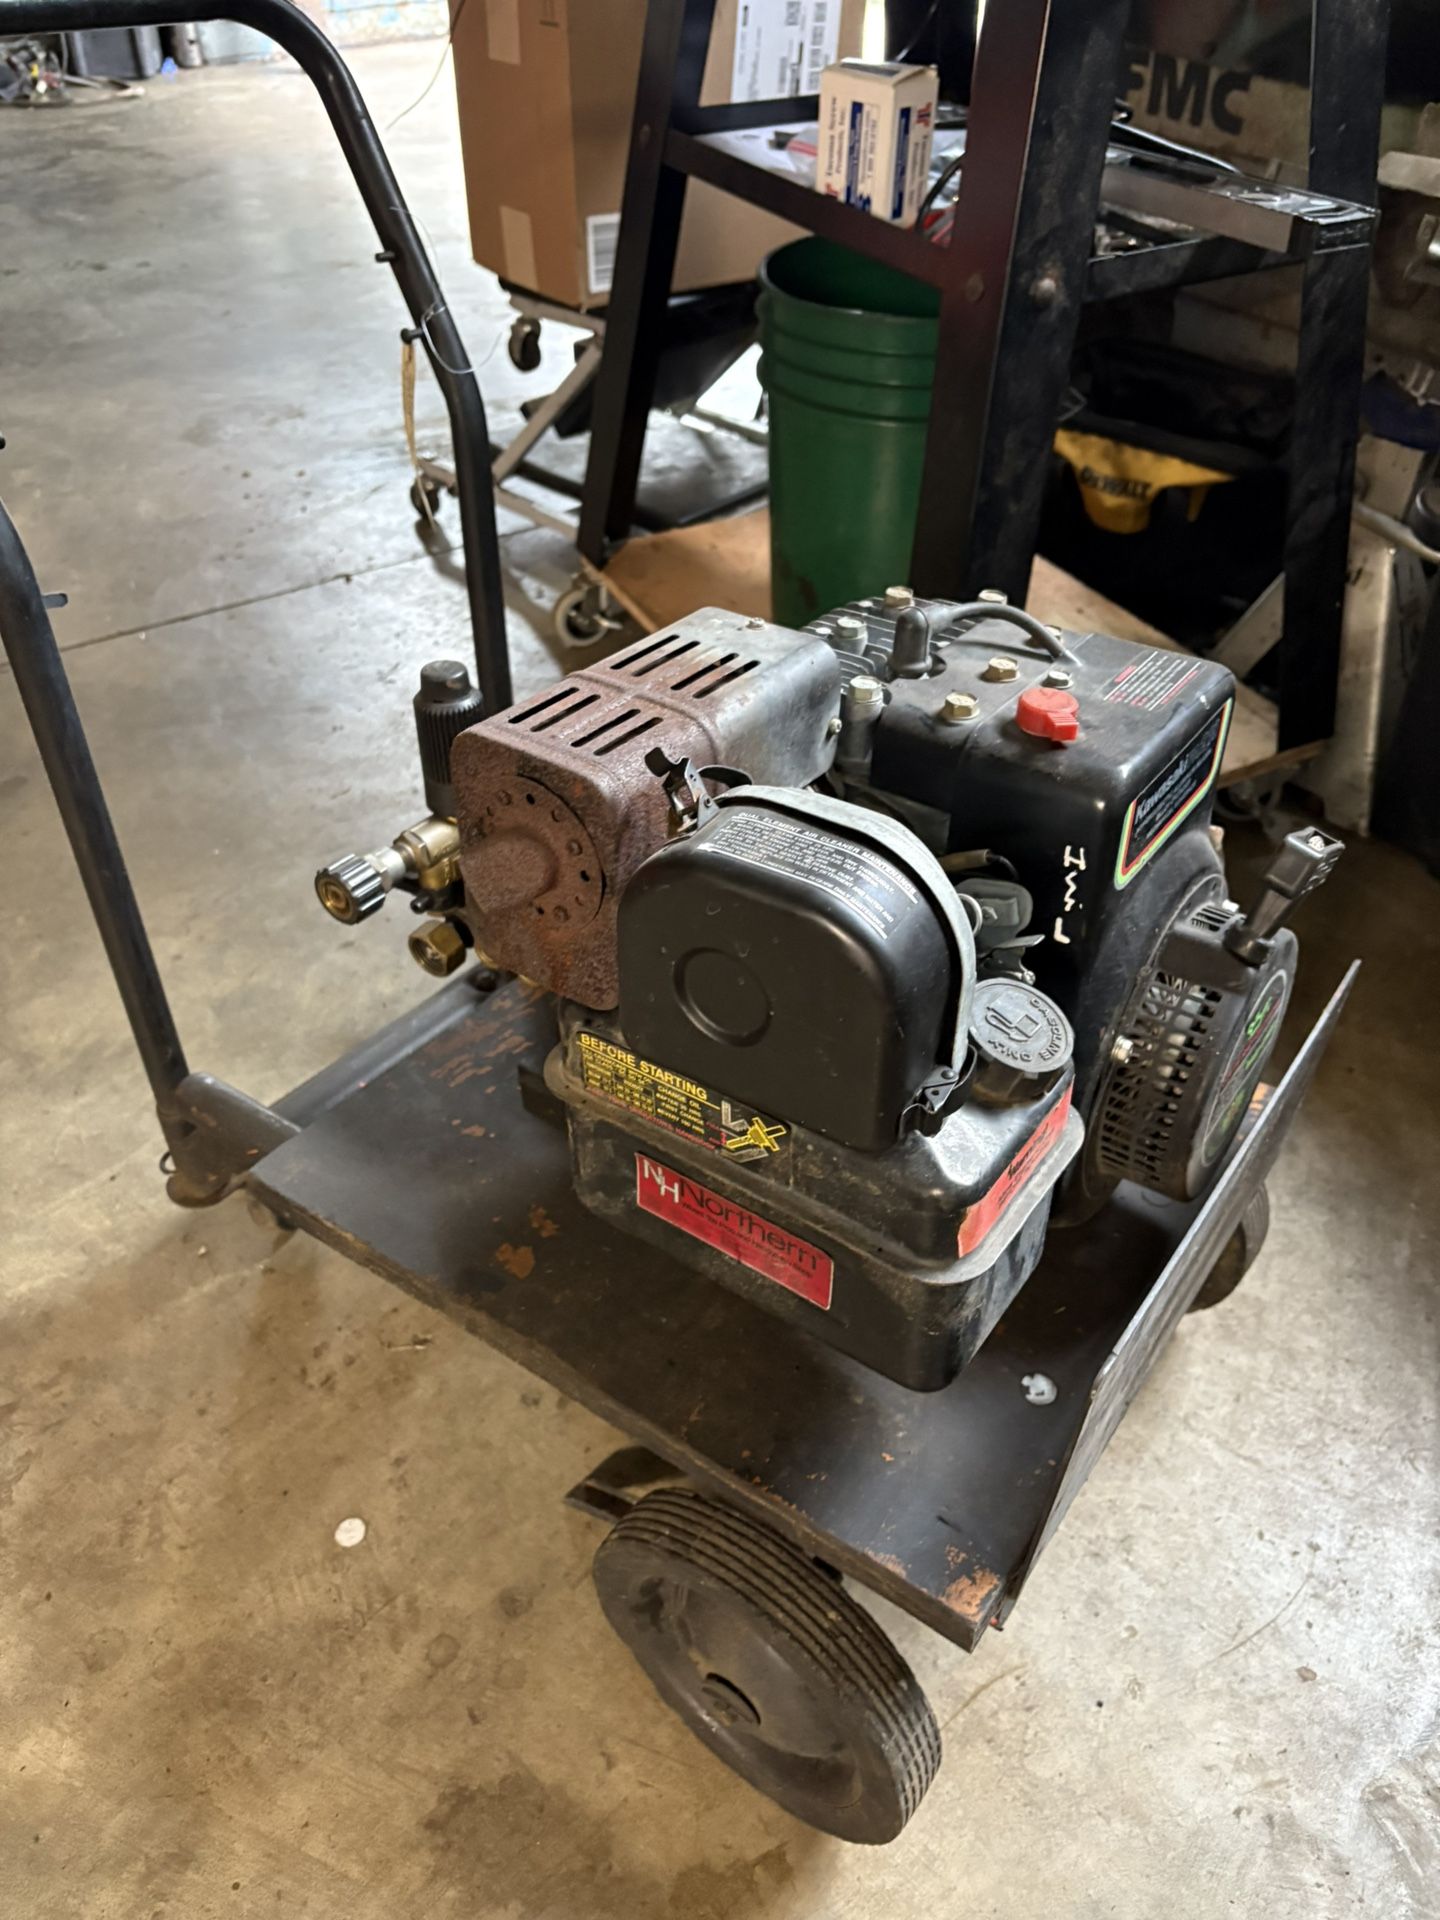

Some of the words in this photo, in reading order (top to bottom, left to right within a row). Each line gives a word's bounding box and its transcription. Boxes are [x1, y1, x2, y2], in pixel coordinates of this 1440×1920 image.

[1126, 55, 1251, 136] FMC
[1134, 753, 1190, 825] Kawasaki
[762, 817, 801, 832] ELEMENT
[802, 830, 818, 838] AIR
[820, 836, 860, 852] CLEANER
[861, 851, 916, 894] MAINTENANCE
[1030, 997, 1062, 1061] GASOLINE
[581, 1032, 636, 1066] BEFORE
[640, 1059, 707, 1100] STARTING
[658, 1085, 686, 1104] CHANGE
[679, 1180, 819, 1270] Northern
